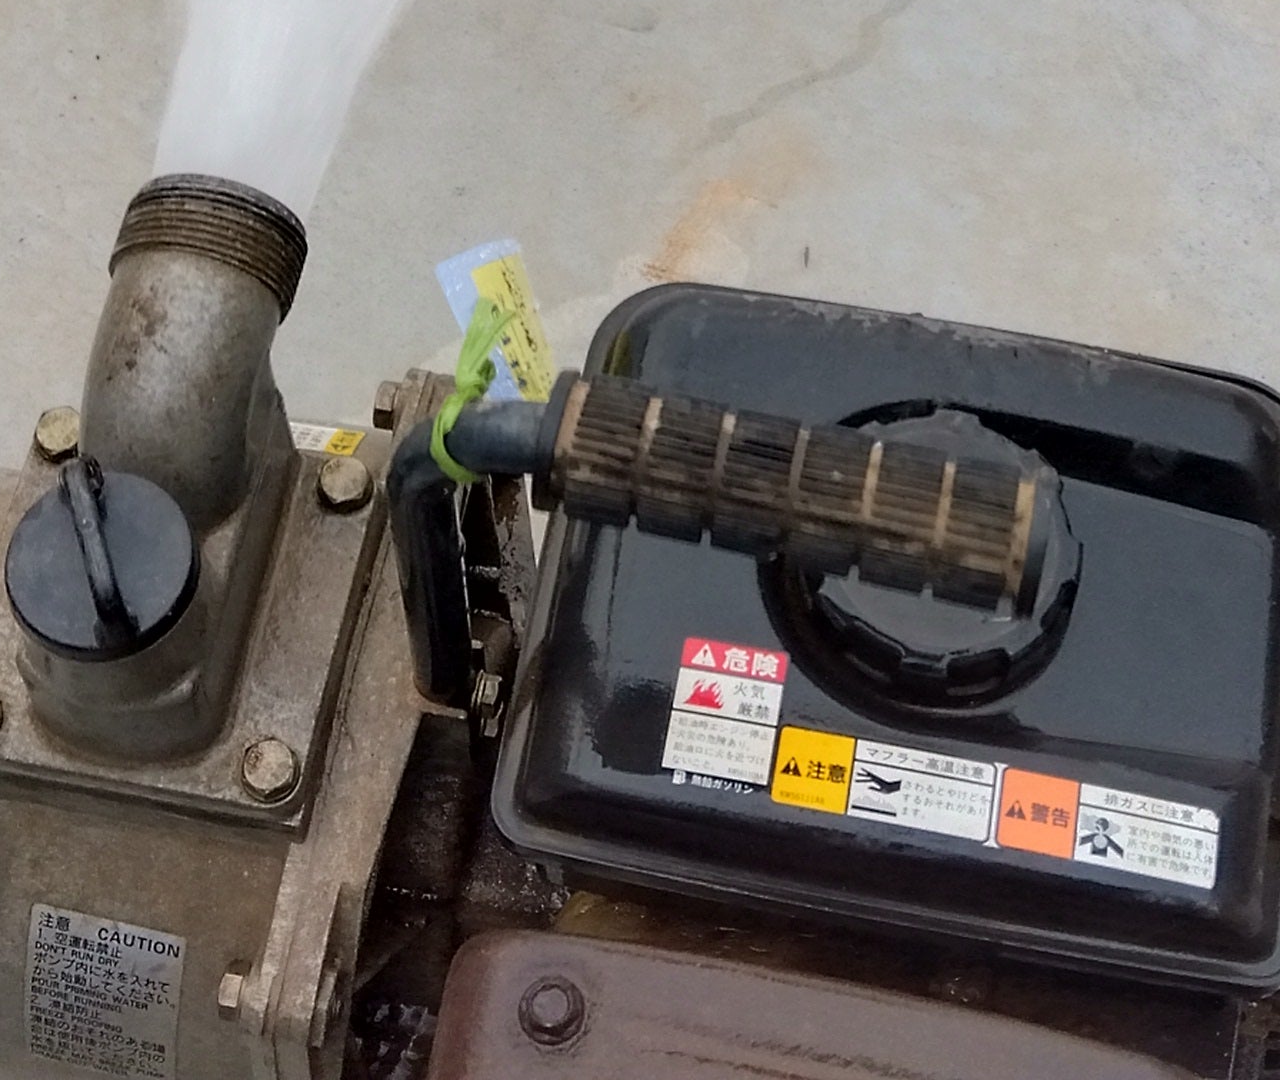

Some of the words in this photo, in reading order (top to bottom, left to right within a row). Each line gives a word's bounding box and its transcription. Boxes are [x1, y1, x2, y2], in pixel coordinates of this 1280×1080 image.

[722, 647, 780, 678] 危険
[733, 682, 766, 700] 火気
[737, 702, 770, 720] 厳禁
[806, 759, 847, 784] 注意
[865, 747, 985, 780] マフラー高温注意
[1030, 801, 1071, 828] 警告
[1104, 792, 1194, 823] 排ガスに注意
[38, 911, 70, 932] 注意
[98, 927, 181, 958] CAUTION
[54, 932, 123, 959] 空運転禁止
[35, 941, 66, 955] DON'T
[71, 949, 94, 962] RUN
[98, 957, 120, 968] DRY
[32, 964, 175, 1010] から始動してください。
[34, 952, 170, 994] ポンプ内に水を入れて
[31, 977, 60, 990] POUR
[64, 984, 107, 1001] PRIMING
[112, 995, 149, 1011] WATER
[31, 985, 70, 1001] BEFORE
[74, 996, 123, 1013] RUNNING
